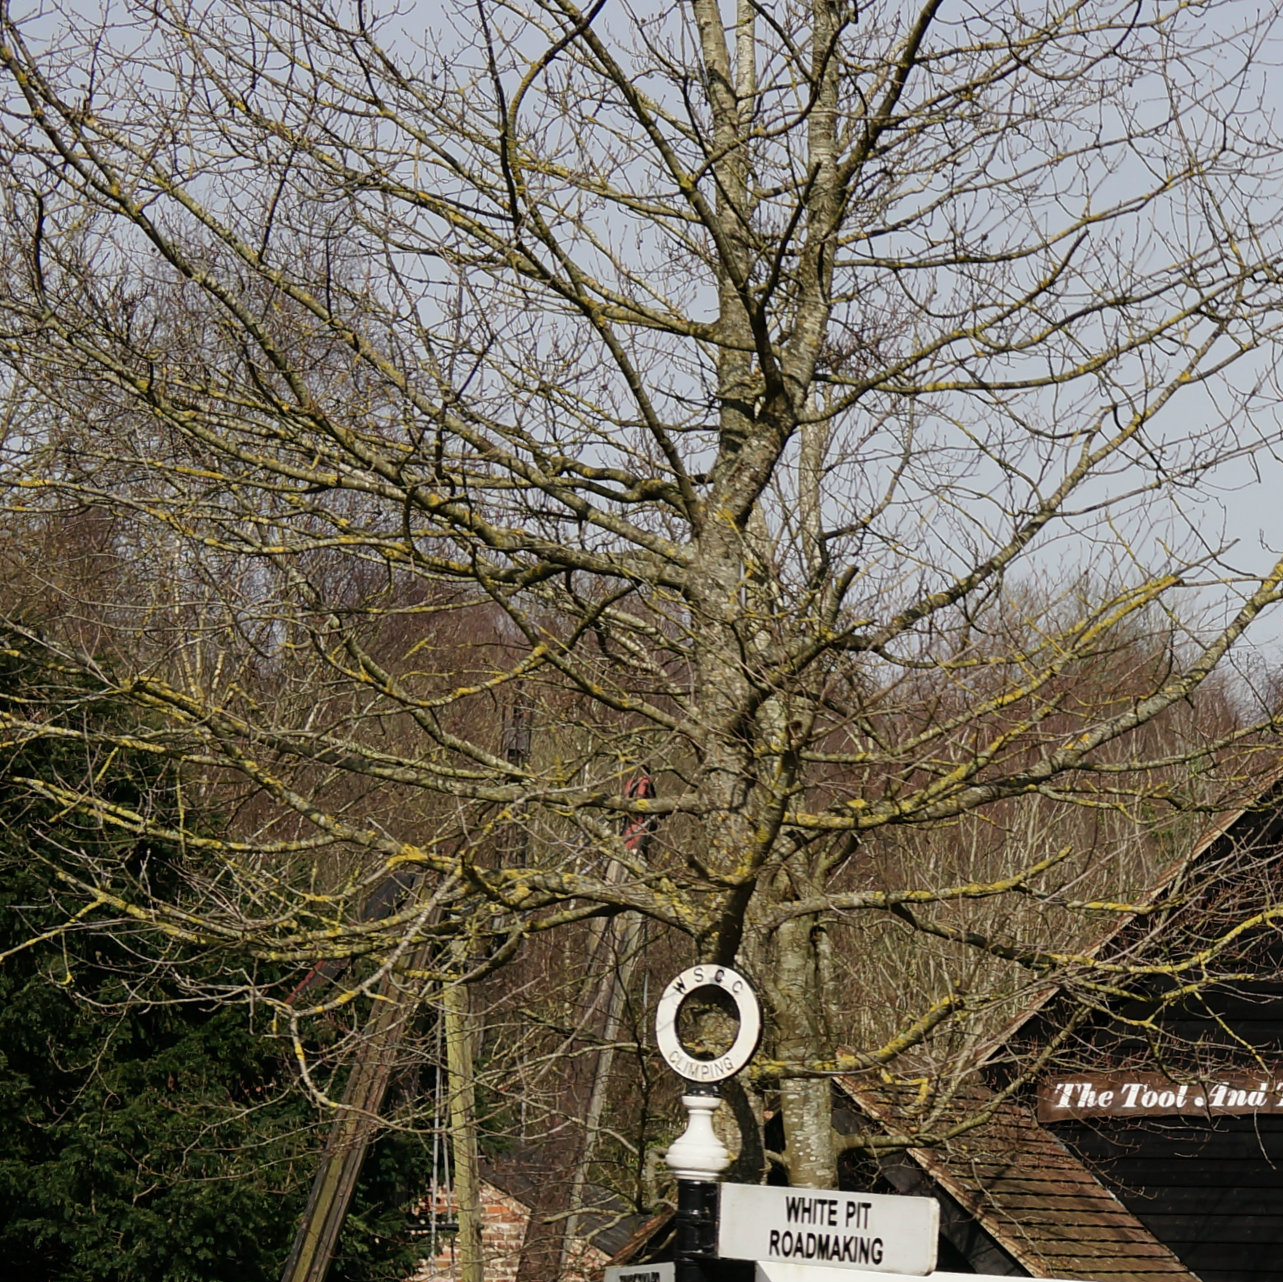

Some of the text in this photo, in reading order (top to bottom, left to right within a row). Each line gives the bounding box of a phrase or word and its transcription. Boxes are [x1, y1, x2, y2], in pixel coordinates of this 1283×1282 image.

[668, 1050, 734, 1080] CLIMPING
[1055, 1082, 1115, 1109] The
[1121, 1082, 1188, 1109] Tool
[1196, 1081, 1268, 1109] And
[785, 1196, 872, 1228] WHITE PIT
[768, 1230, 884, 1265] ROADMAKING
